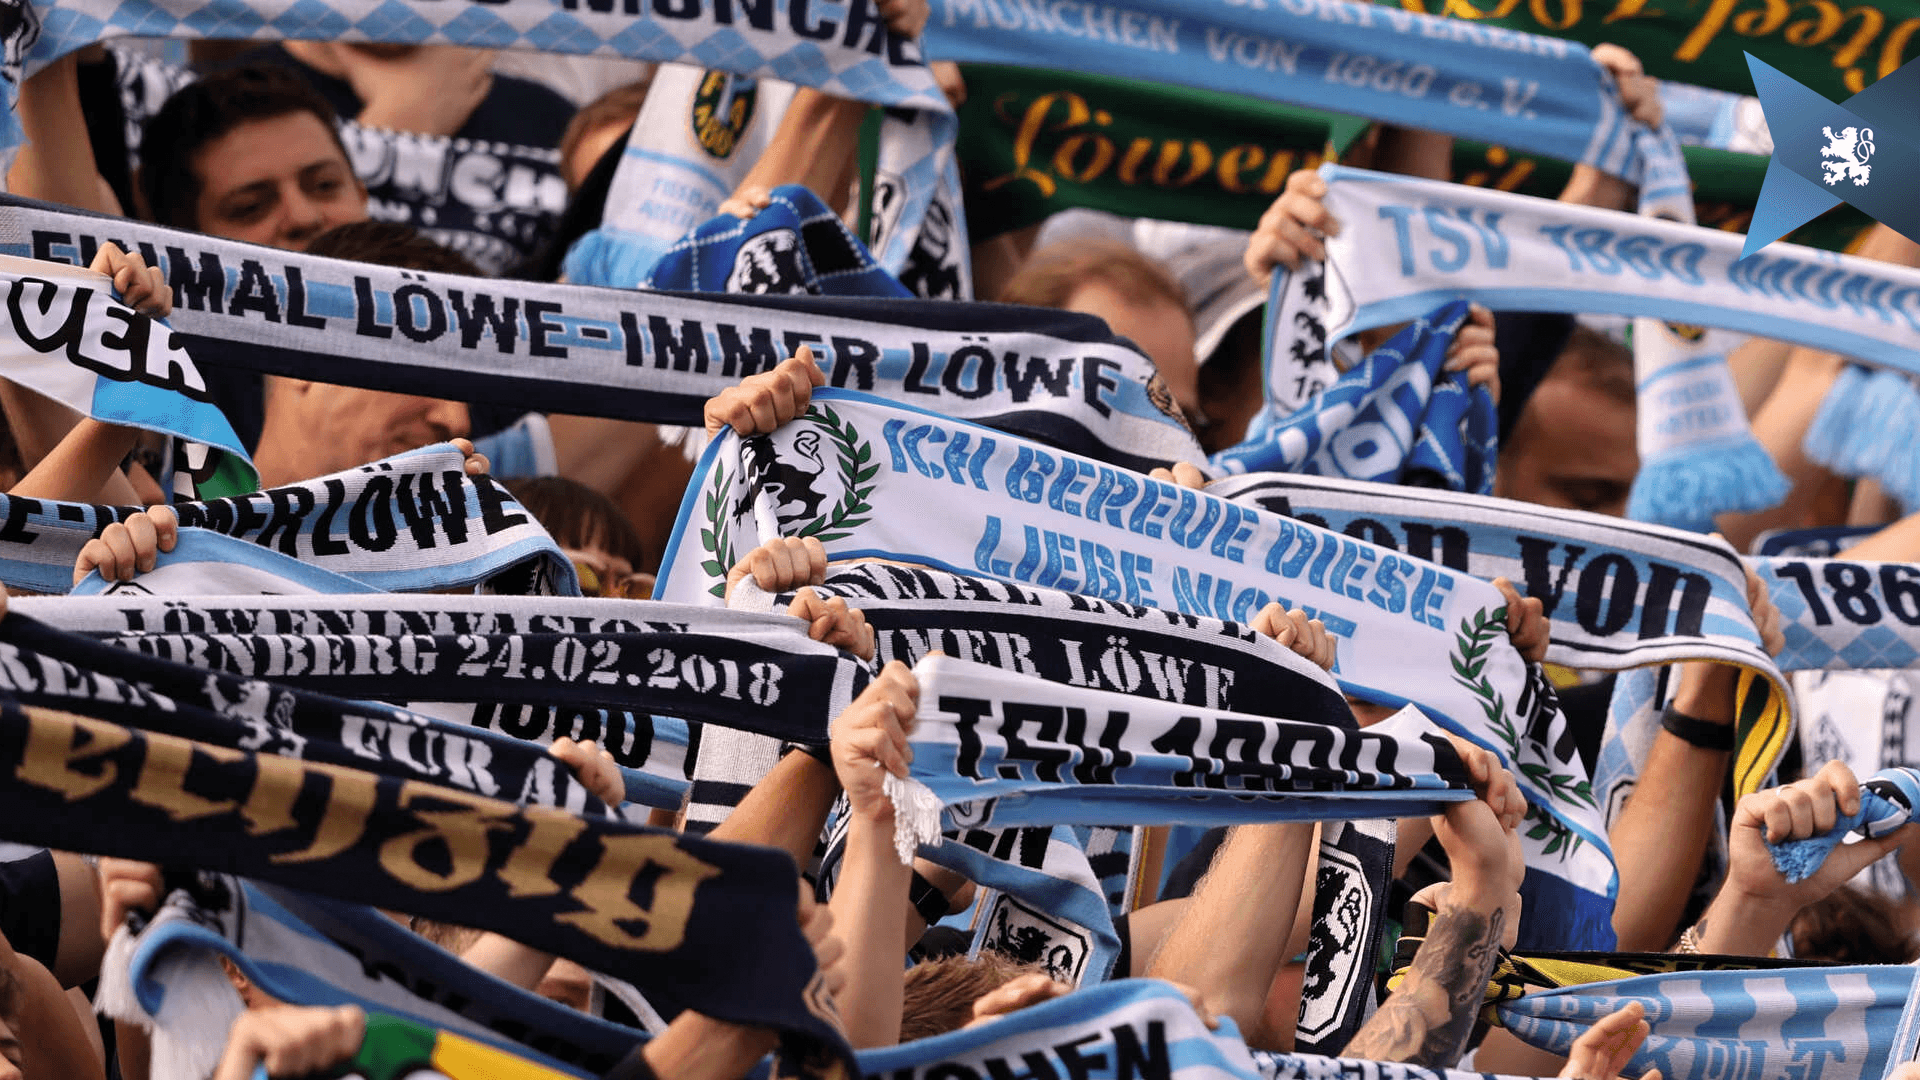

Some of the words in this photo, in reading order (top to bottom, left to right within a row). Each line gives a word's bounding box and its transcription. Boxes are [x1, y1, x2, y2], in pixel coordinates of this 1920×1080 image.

[1206, 28, 1301, 75] VON
[1325, 52, 1437, 98] 1860
[1378, 206, 1509, 278] TSV
[1539, 222, 1706, 286] 1860
[904, 335, 1122, 419] LÖWE
[313, 463, 529, 556] LÖWE
[883, 418, 997, 492] ICH
[1005, 444, 1260, 564] BEREUE
[1265, 518, 1455, 632] DIESE
[975, 515, 1158, 608] LIEBE
[456, 634, 784, 706] 24.02.2018
[1059, 633, 1236, 712] LÖWE
[341, 710, 500, 797] FÜR
